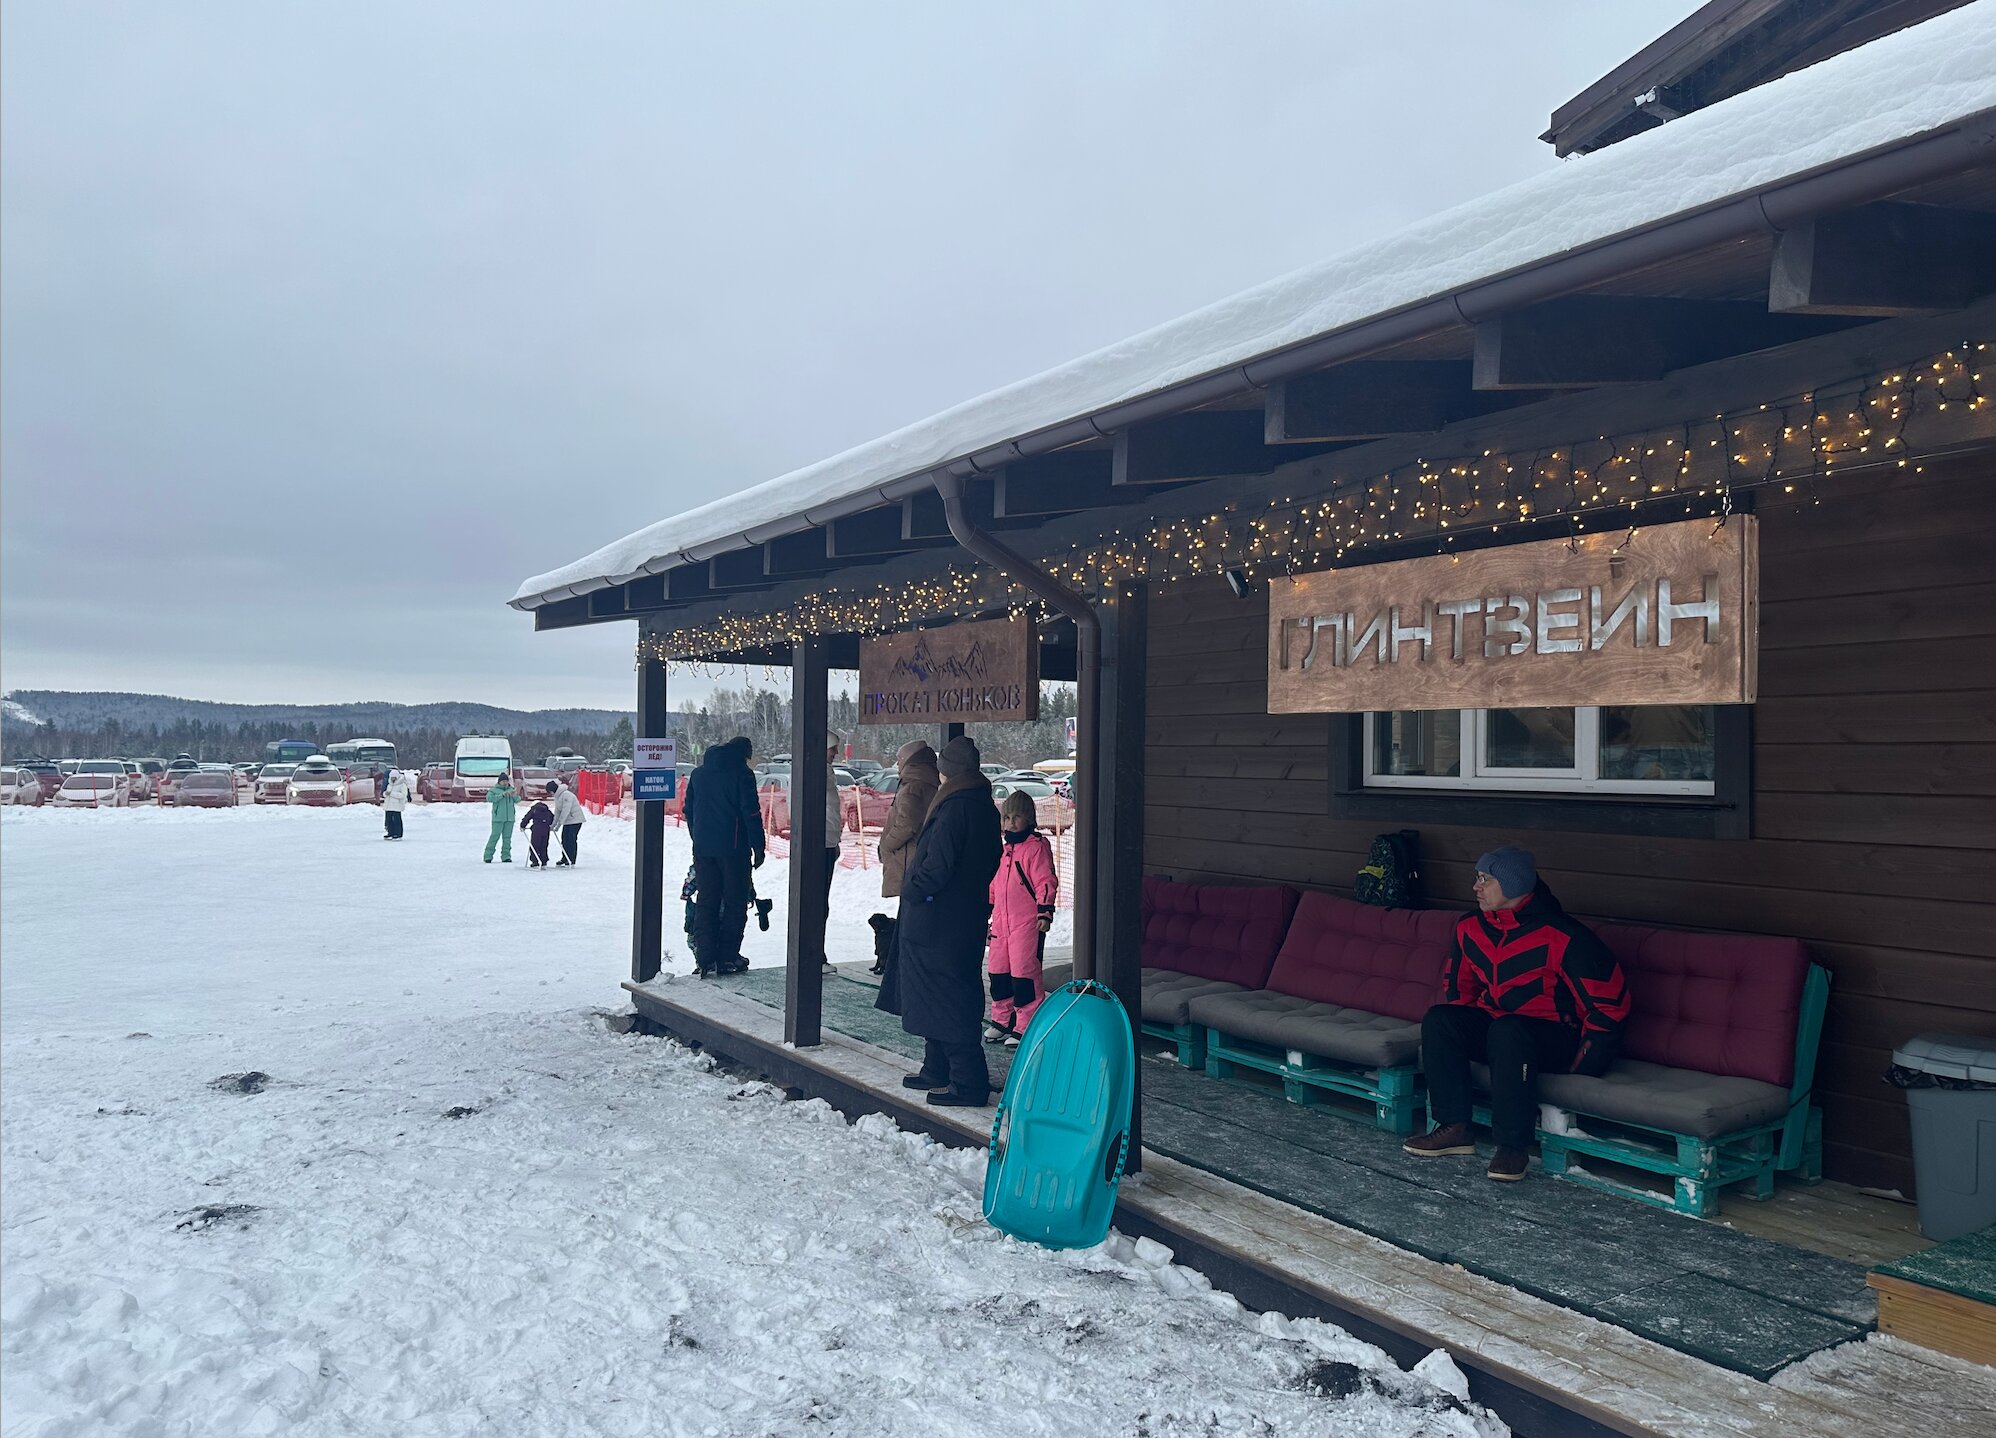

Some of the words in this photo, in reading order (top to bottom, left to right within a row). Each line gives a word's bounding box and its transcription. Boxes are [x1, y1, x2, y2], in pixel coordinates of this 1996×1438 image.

[863, 690, 931, 715] ПРОКАТ
[937, 684, 1021, 713] КОНЬКОВ
[637, 744, 672, 752] ОСТОРОЖНО
[640, 784, 669, 792] ПЛАТНЫЙ
